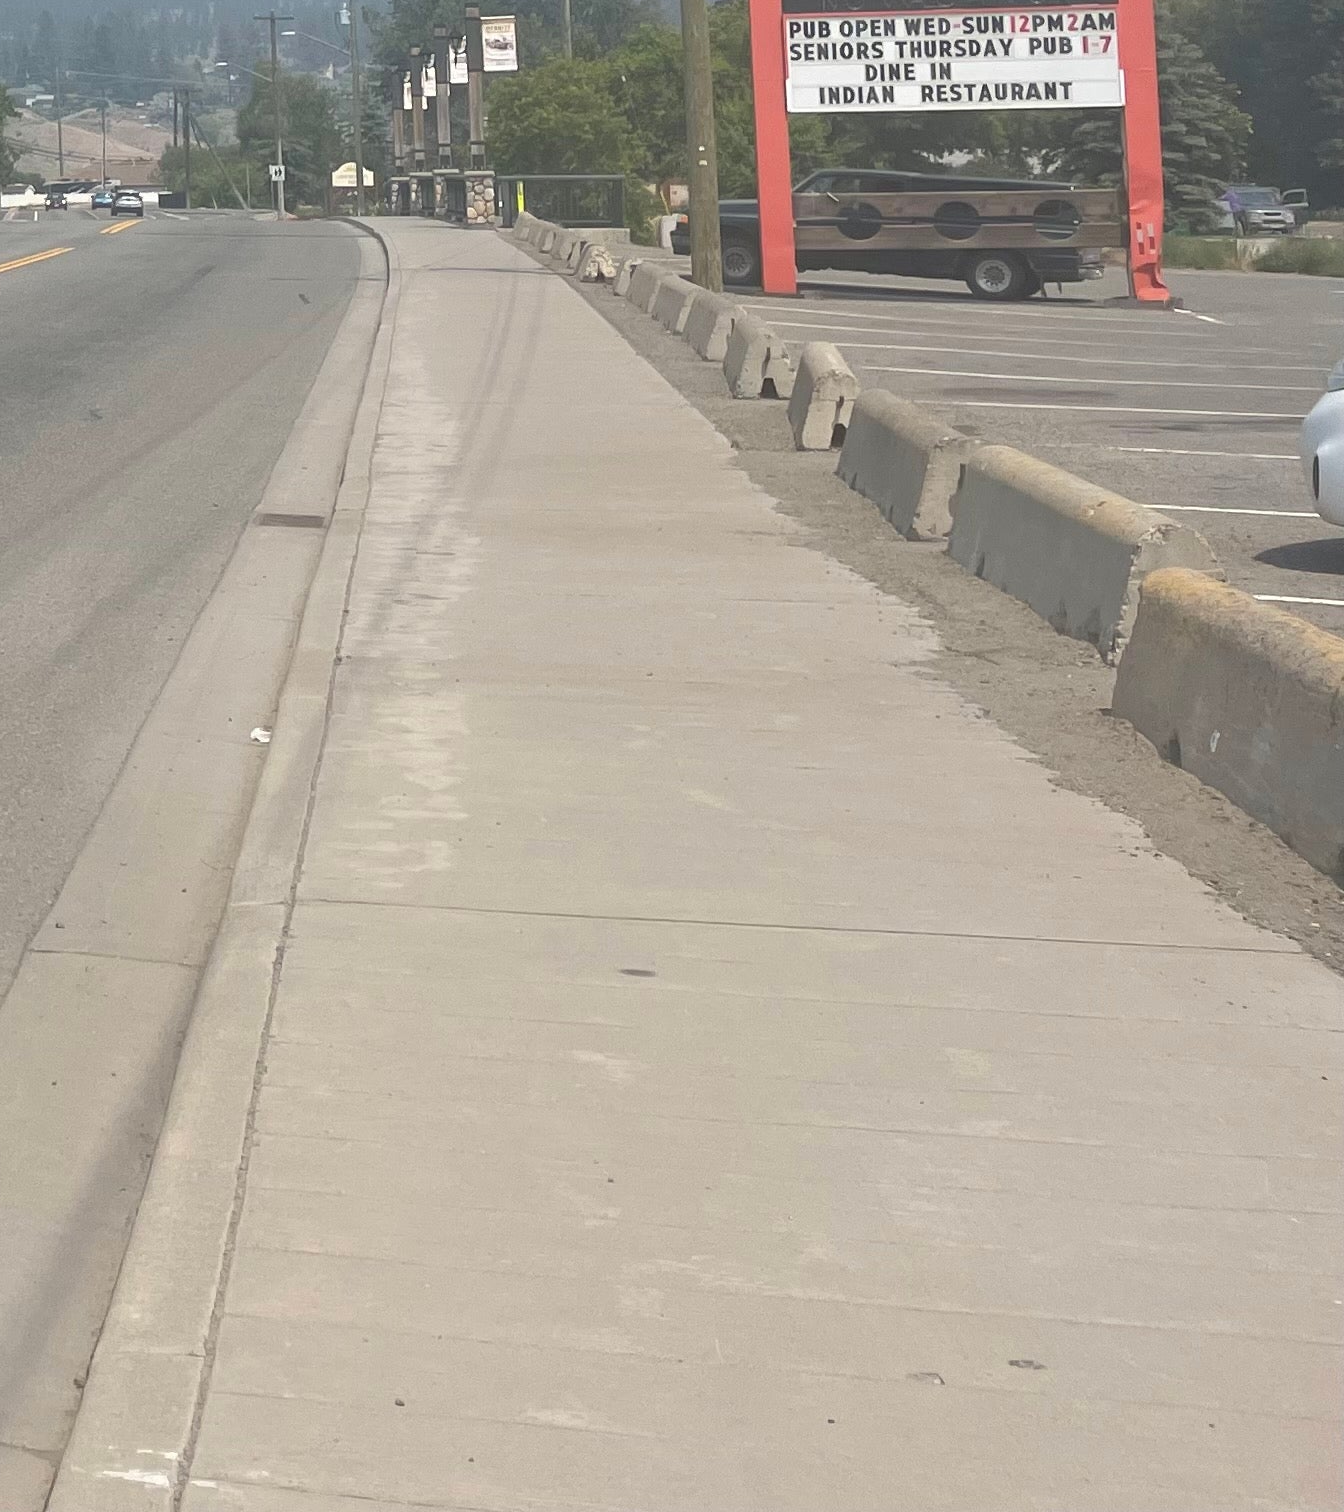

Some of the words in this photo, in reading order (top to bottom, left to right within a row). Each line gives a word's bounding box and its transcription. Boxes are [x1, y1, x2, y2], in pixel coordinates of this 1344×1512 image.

[789, 21, 831, 38] PUB
[839, 19, 896, 38] OPEN
[789, 41, 884, 61] SENIORS
[895, 38, 1013, 59] THURSDAY
[1029, 36, 1073, 55] PUB
[1082, 35, 1112, 54] 1-7
[865, 63, 916, 82] DINE
[930, 62, 952, 81] IN
[818, 86, 895, 105] INDIAN
[921, 82, 1073, 102] RESTAURANT
